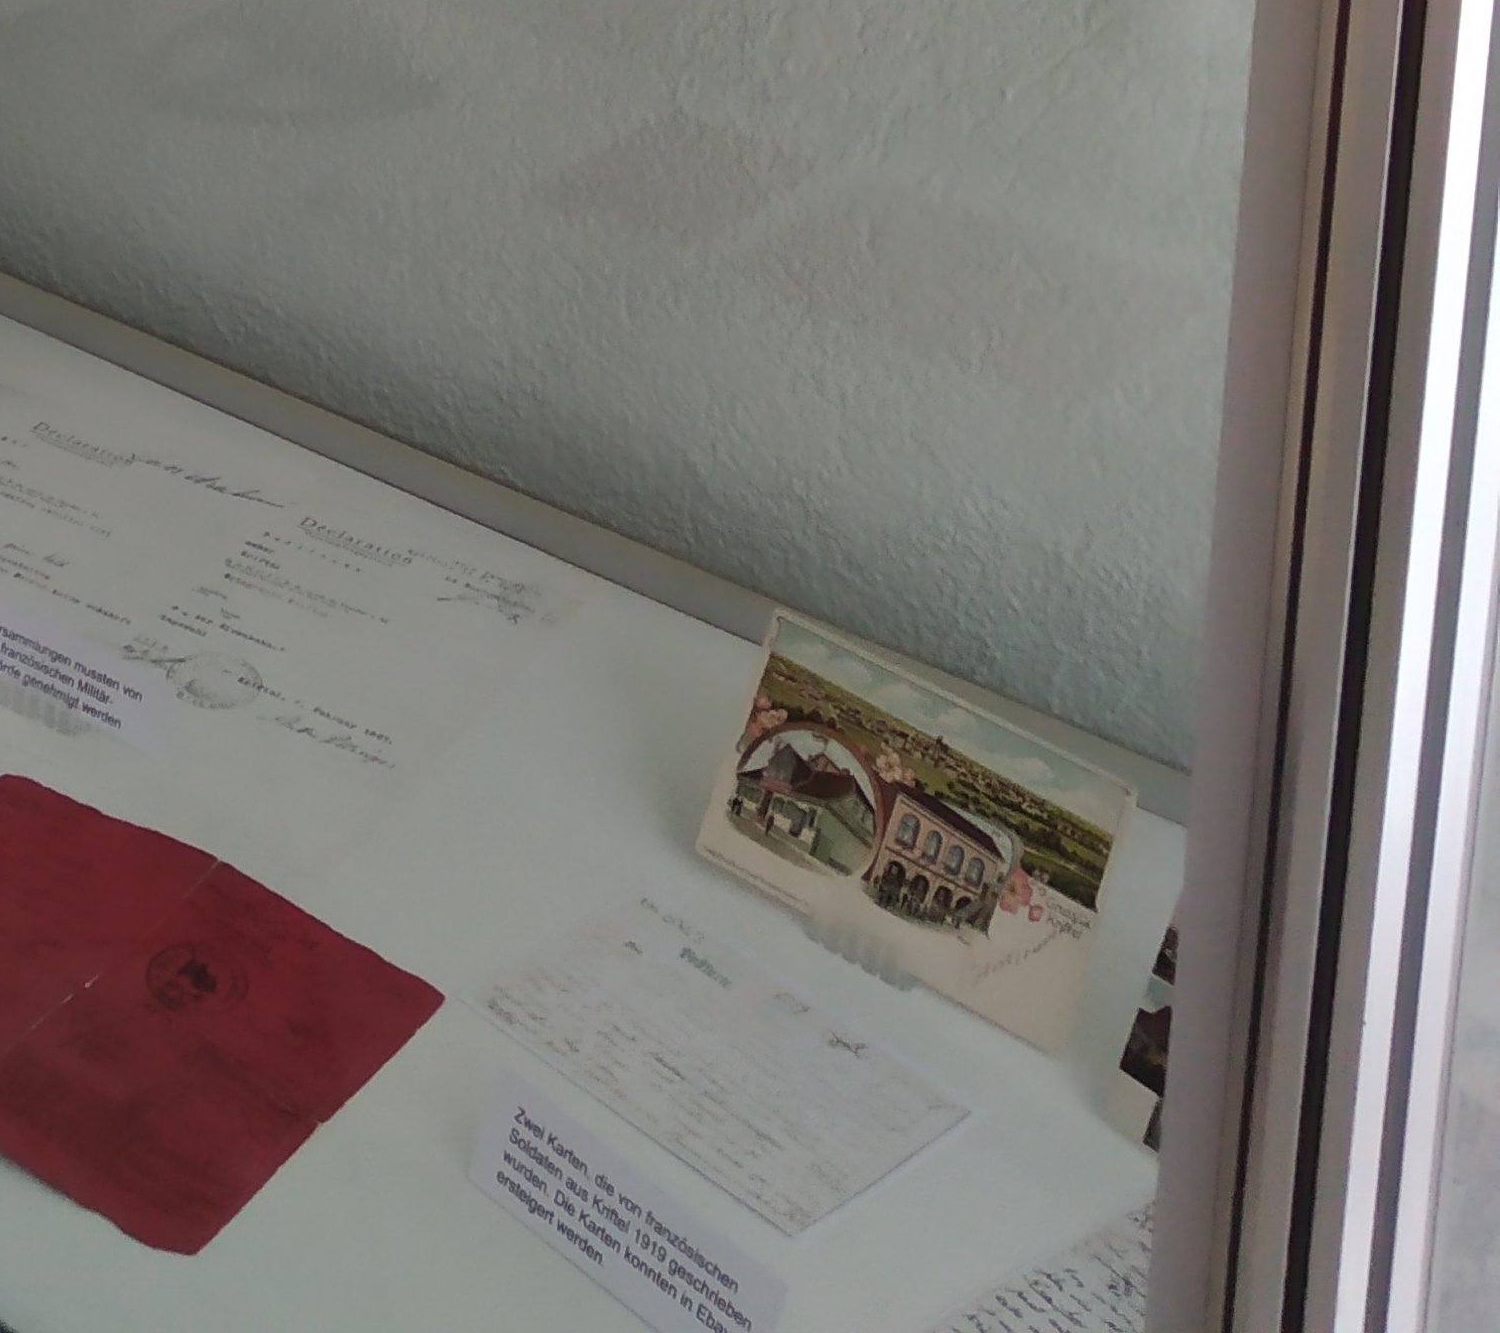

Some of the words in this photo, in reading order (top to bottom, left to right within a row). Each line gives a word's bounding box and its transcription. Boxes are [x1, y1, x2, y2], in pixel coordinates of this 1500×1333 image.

[0, 641, 75, 688] französischen
[73, 661, 120, 691] mussten
[122, 684, 143, 702] von
[21, 673, 80, 710] genehmigt
[81, 701, 122, 729] werden
[496, 1170, 555, 1225] ersteigert
[513, 1105, 545, 1141] Zwei
[594, 1173, 615, 1197] die
[617, 1191, 643, 1219] von
[644, 1210, 739, 1294] französischen
[508, 1127, 563, 1182] Soldaten
[564, 1176, 589, 1203] aus
[591, 1193, 631, 1234] Kriftel
[634, 1227, 668, 1263] 1919
[667, 1258, 752, 1333] geschrieben
[553, 1188, 576, 1217] Die
[577, 1208, 621, 1254] Karten
[623, 1244, 678, 1300] konnten
[679, 1290, 693, 1312] in
